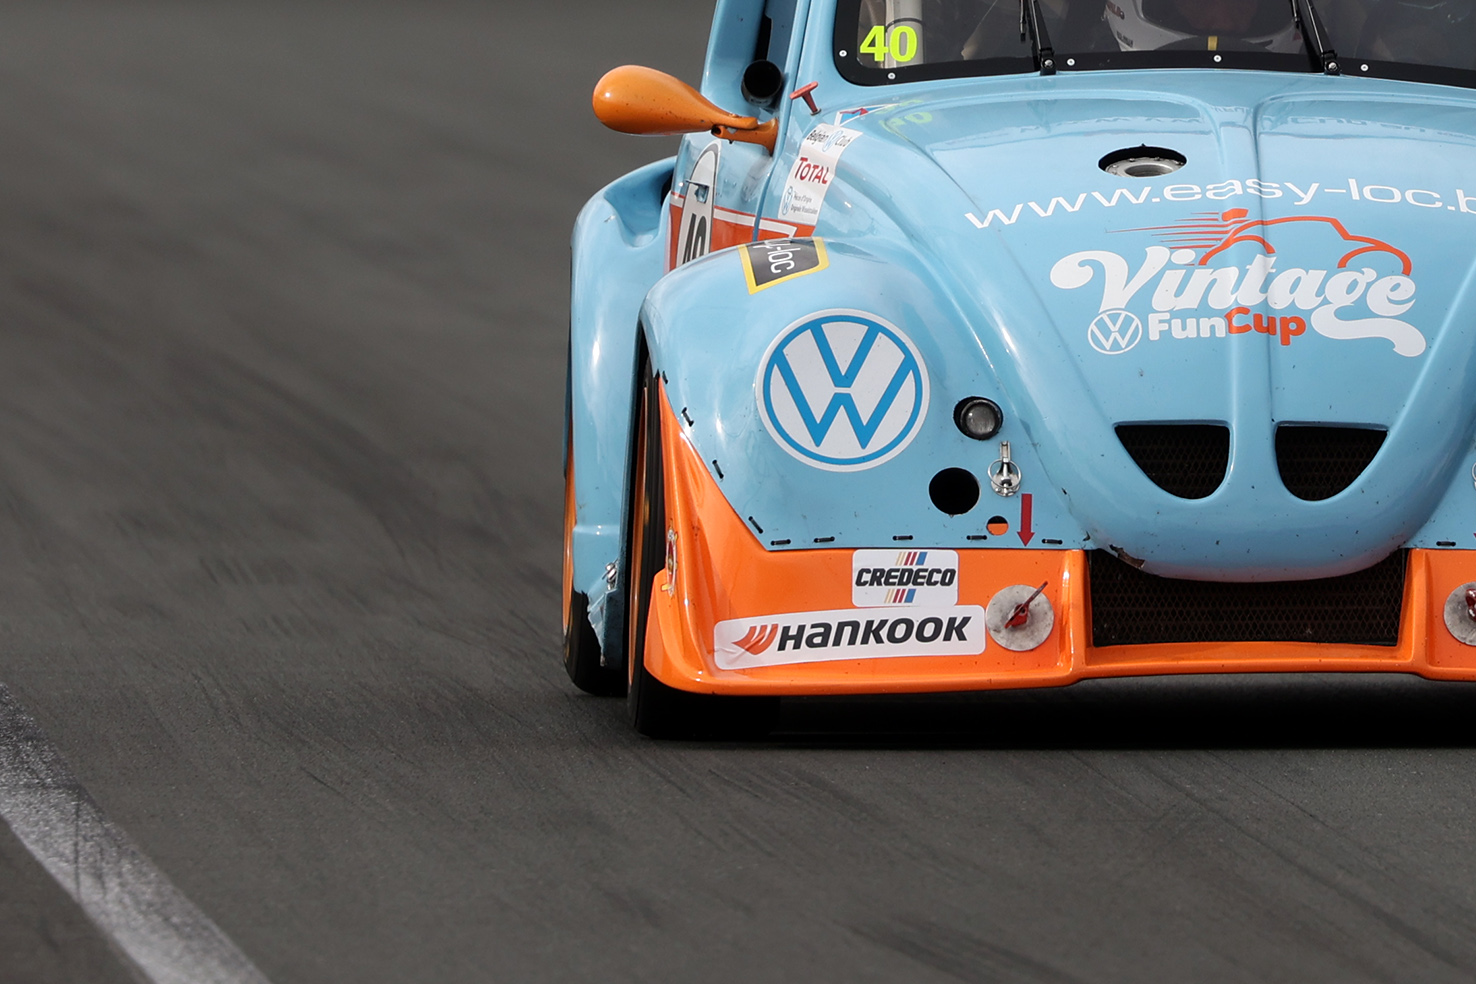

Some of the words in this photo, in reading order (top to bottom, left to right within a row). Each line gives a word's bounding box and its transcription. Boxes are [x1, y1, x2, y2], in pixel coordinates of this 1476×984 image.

[859, 25, 918, 63] 40
[794, 157, 830, 185] TOTAL
[1049, 245, 1427, 358] Vintage
[1147, 306, 1307, 346] FunCup
[855, 567, 956, 587] CREDECO
